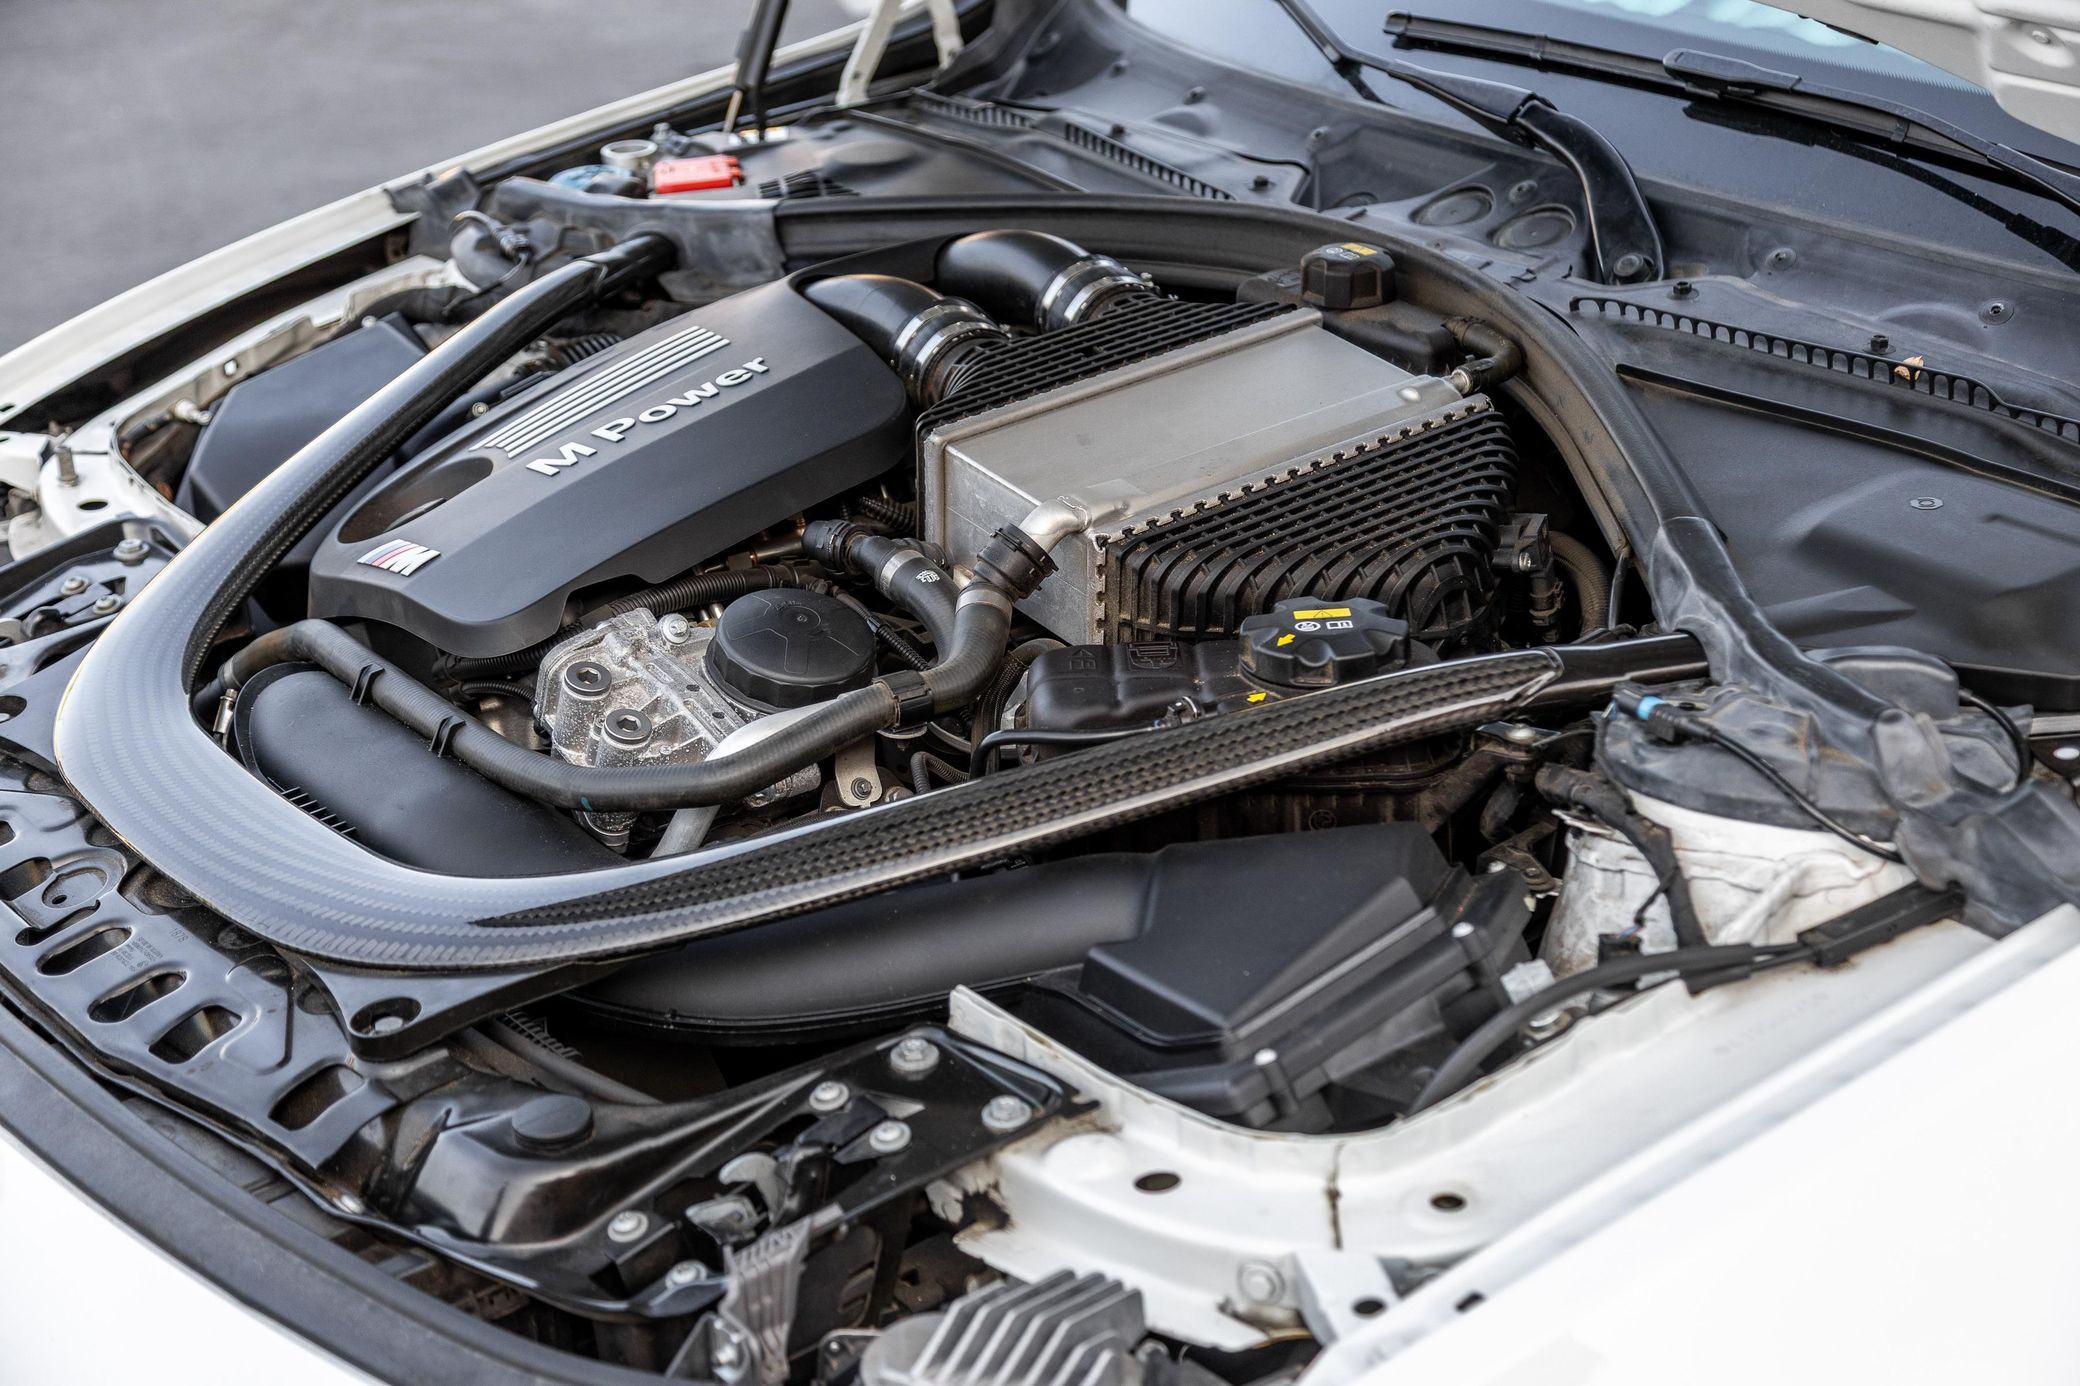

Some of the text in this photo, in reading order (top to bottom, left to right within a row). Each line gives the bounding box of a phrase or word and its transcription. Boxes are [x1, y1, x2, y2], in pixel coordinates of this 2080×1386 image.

[526, 357, 769, 477] M Power
[374, 543, 441, 577] M
